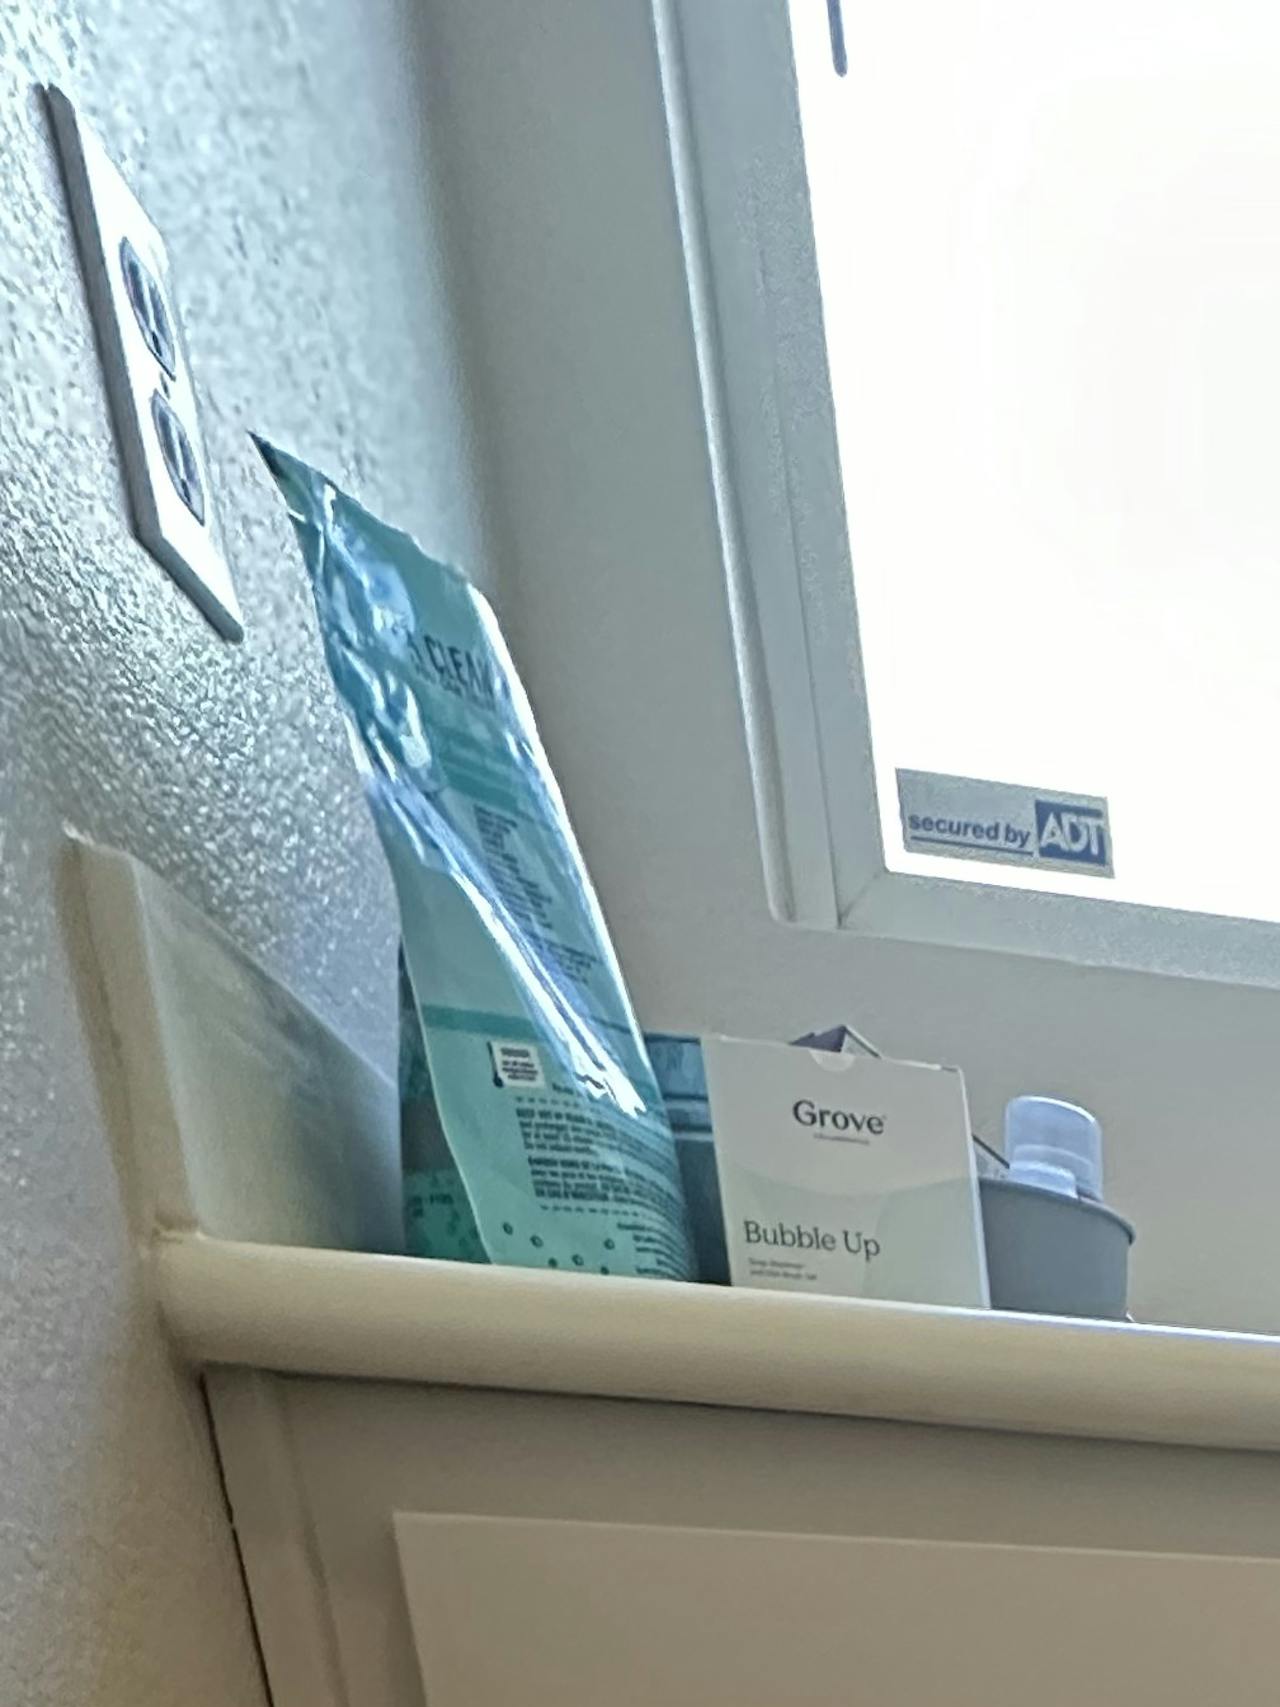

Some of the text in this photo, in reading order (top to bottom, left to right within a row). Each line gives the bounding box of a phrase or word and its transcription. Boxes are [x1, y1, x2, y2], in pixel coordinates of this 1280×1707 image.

[908, 811, 1104, 856] secured by ADT
[793, 1099, 884, 1135] Grove
[744, 1220, 881, 1263] Bubble Up
